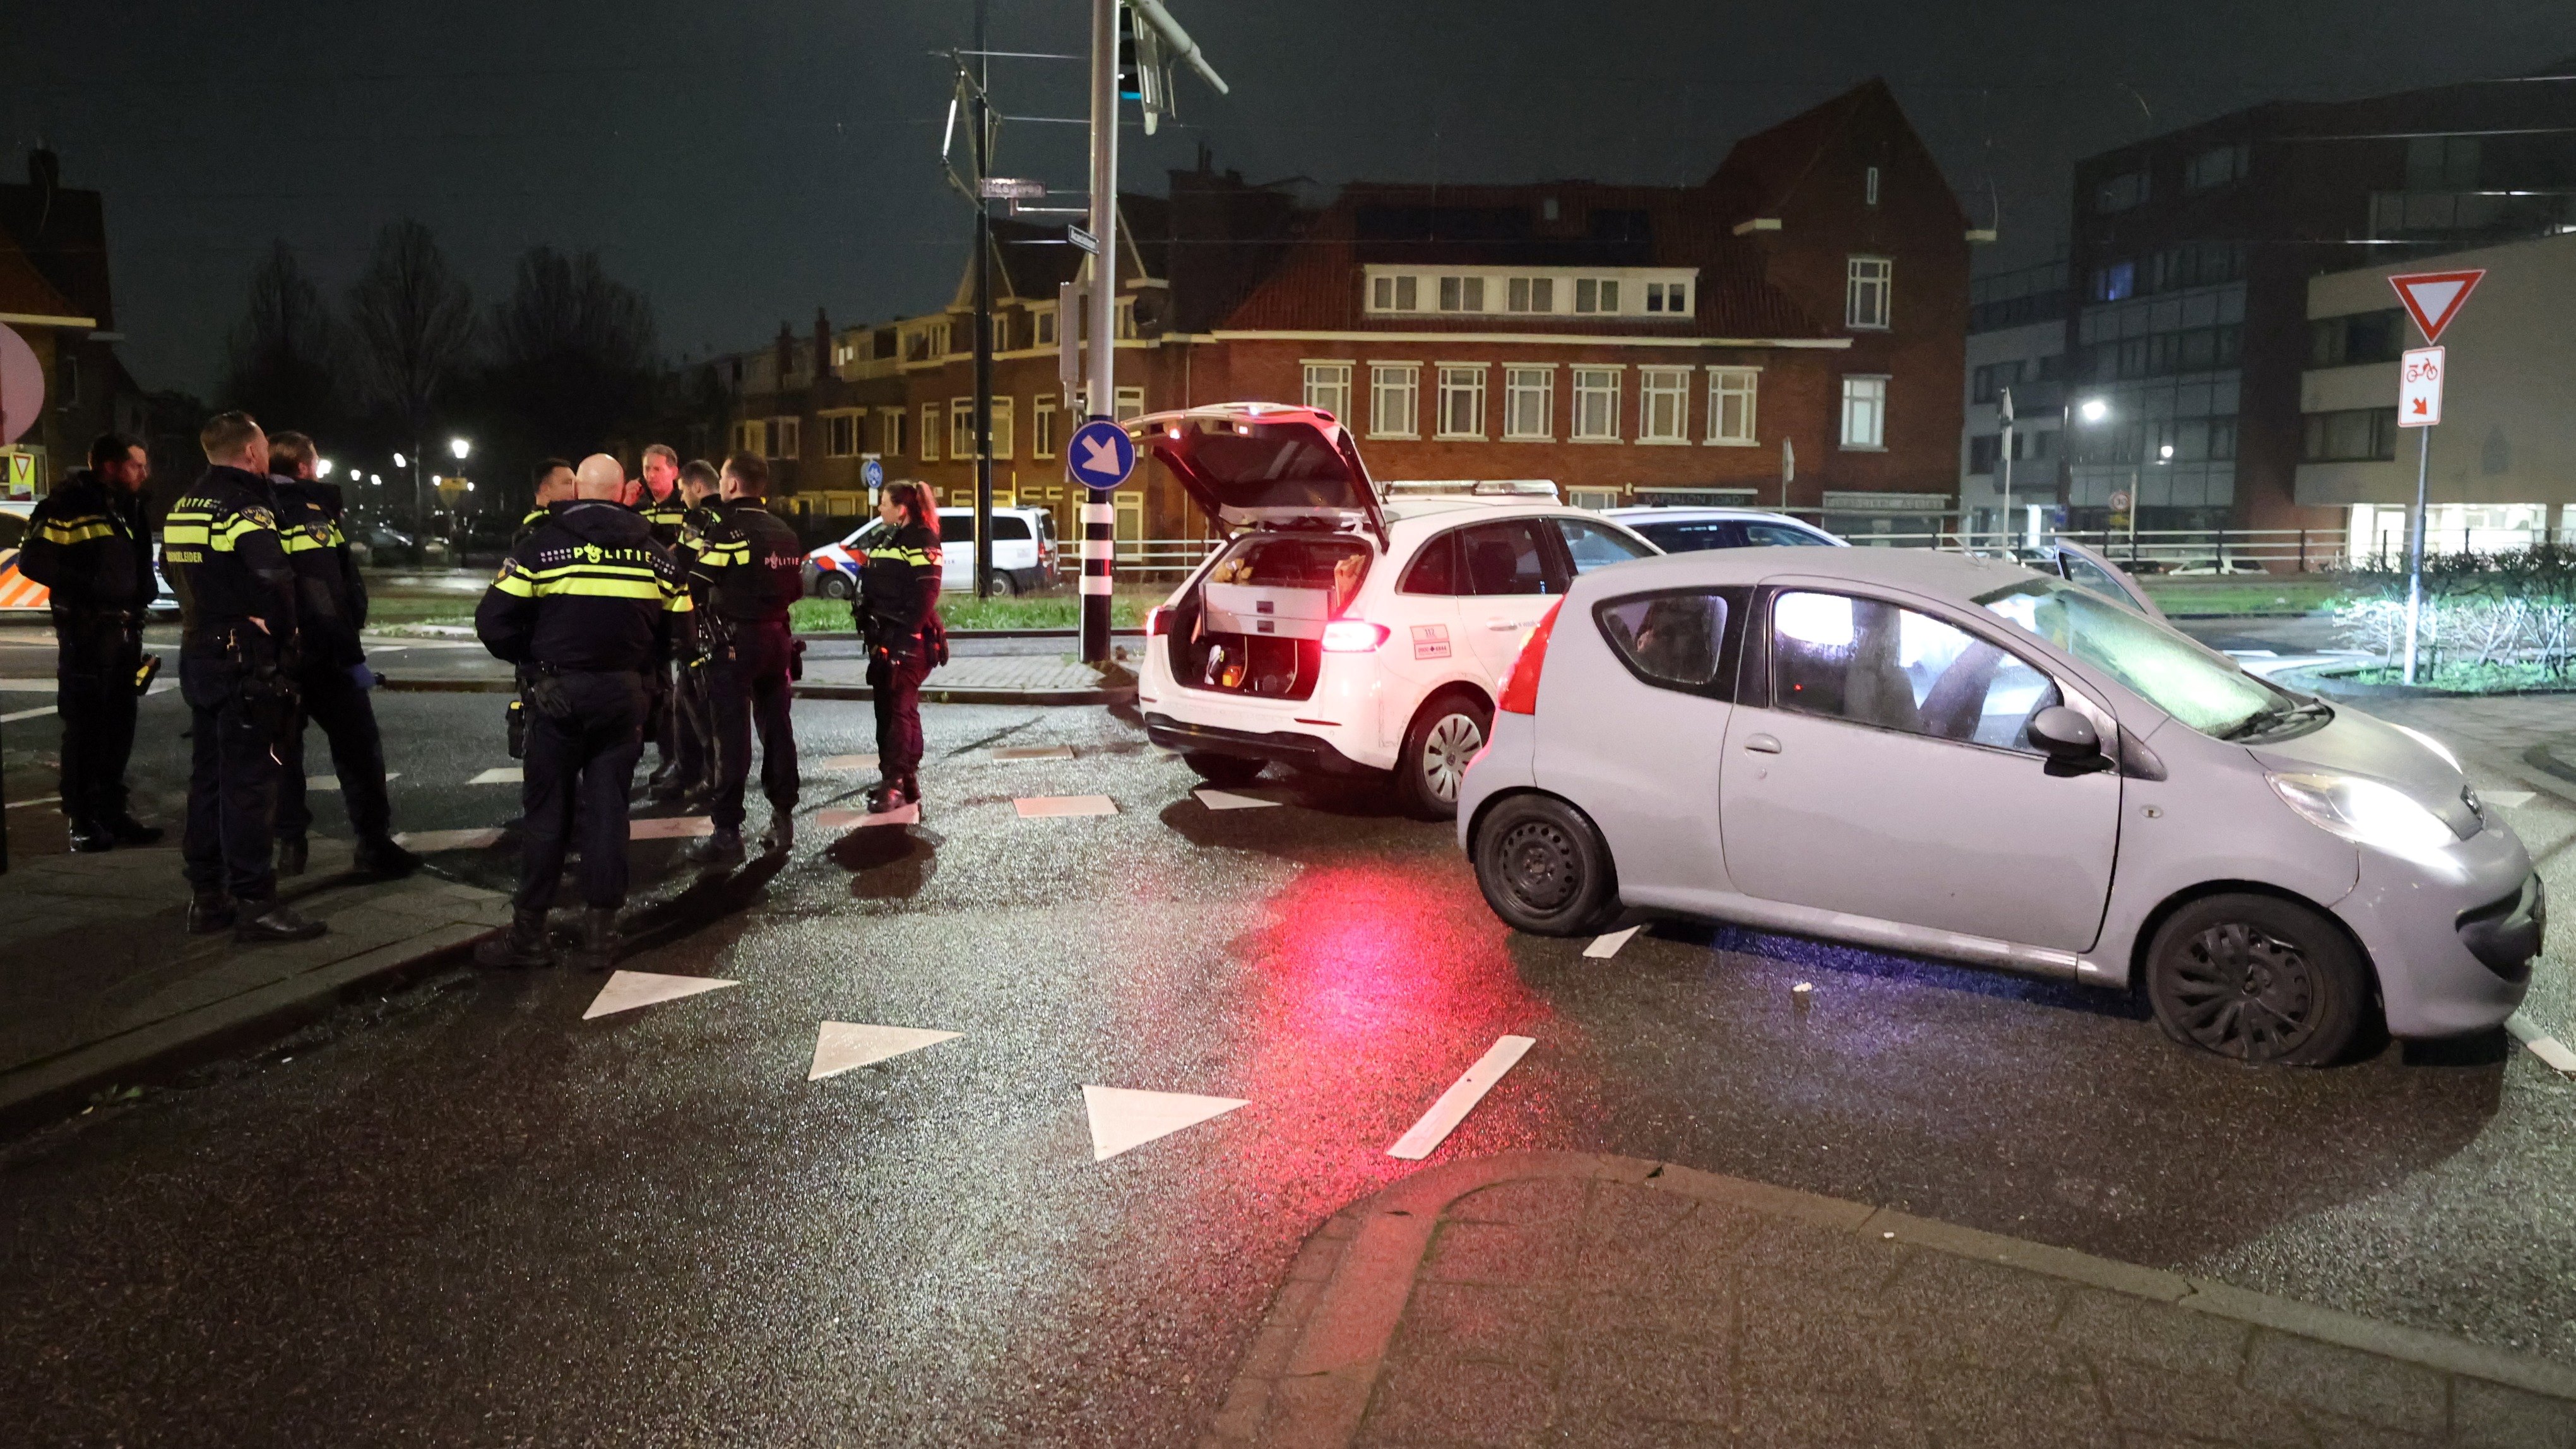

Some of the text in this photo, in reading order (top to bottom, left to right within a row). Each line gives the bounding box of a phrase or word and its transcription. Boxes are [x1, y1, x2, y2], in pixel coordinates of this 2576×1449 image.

[1644, 494, 1706, 504] KAPSALON
[573, 543, 652, 563] POLITIE
[764, 551, 799, 569] POLITIE
